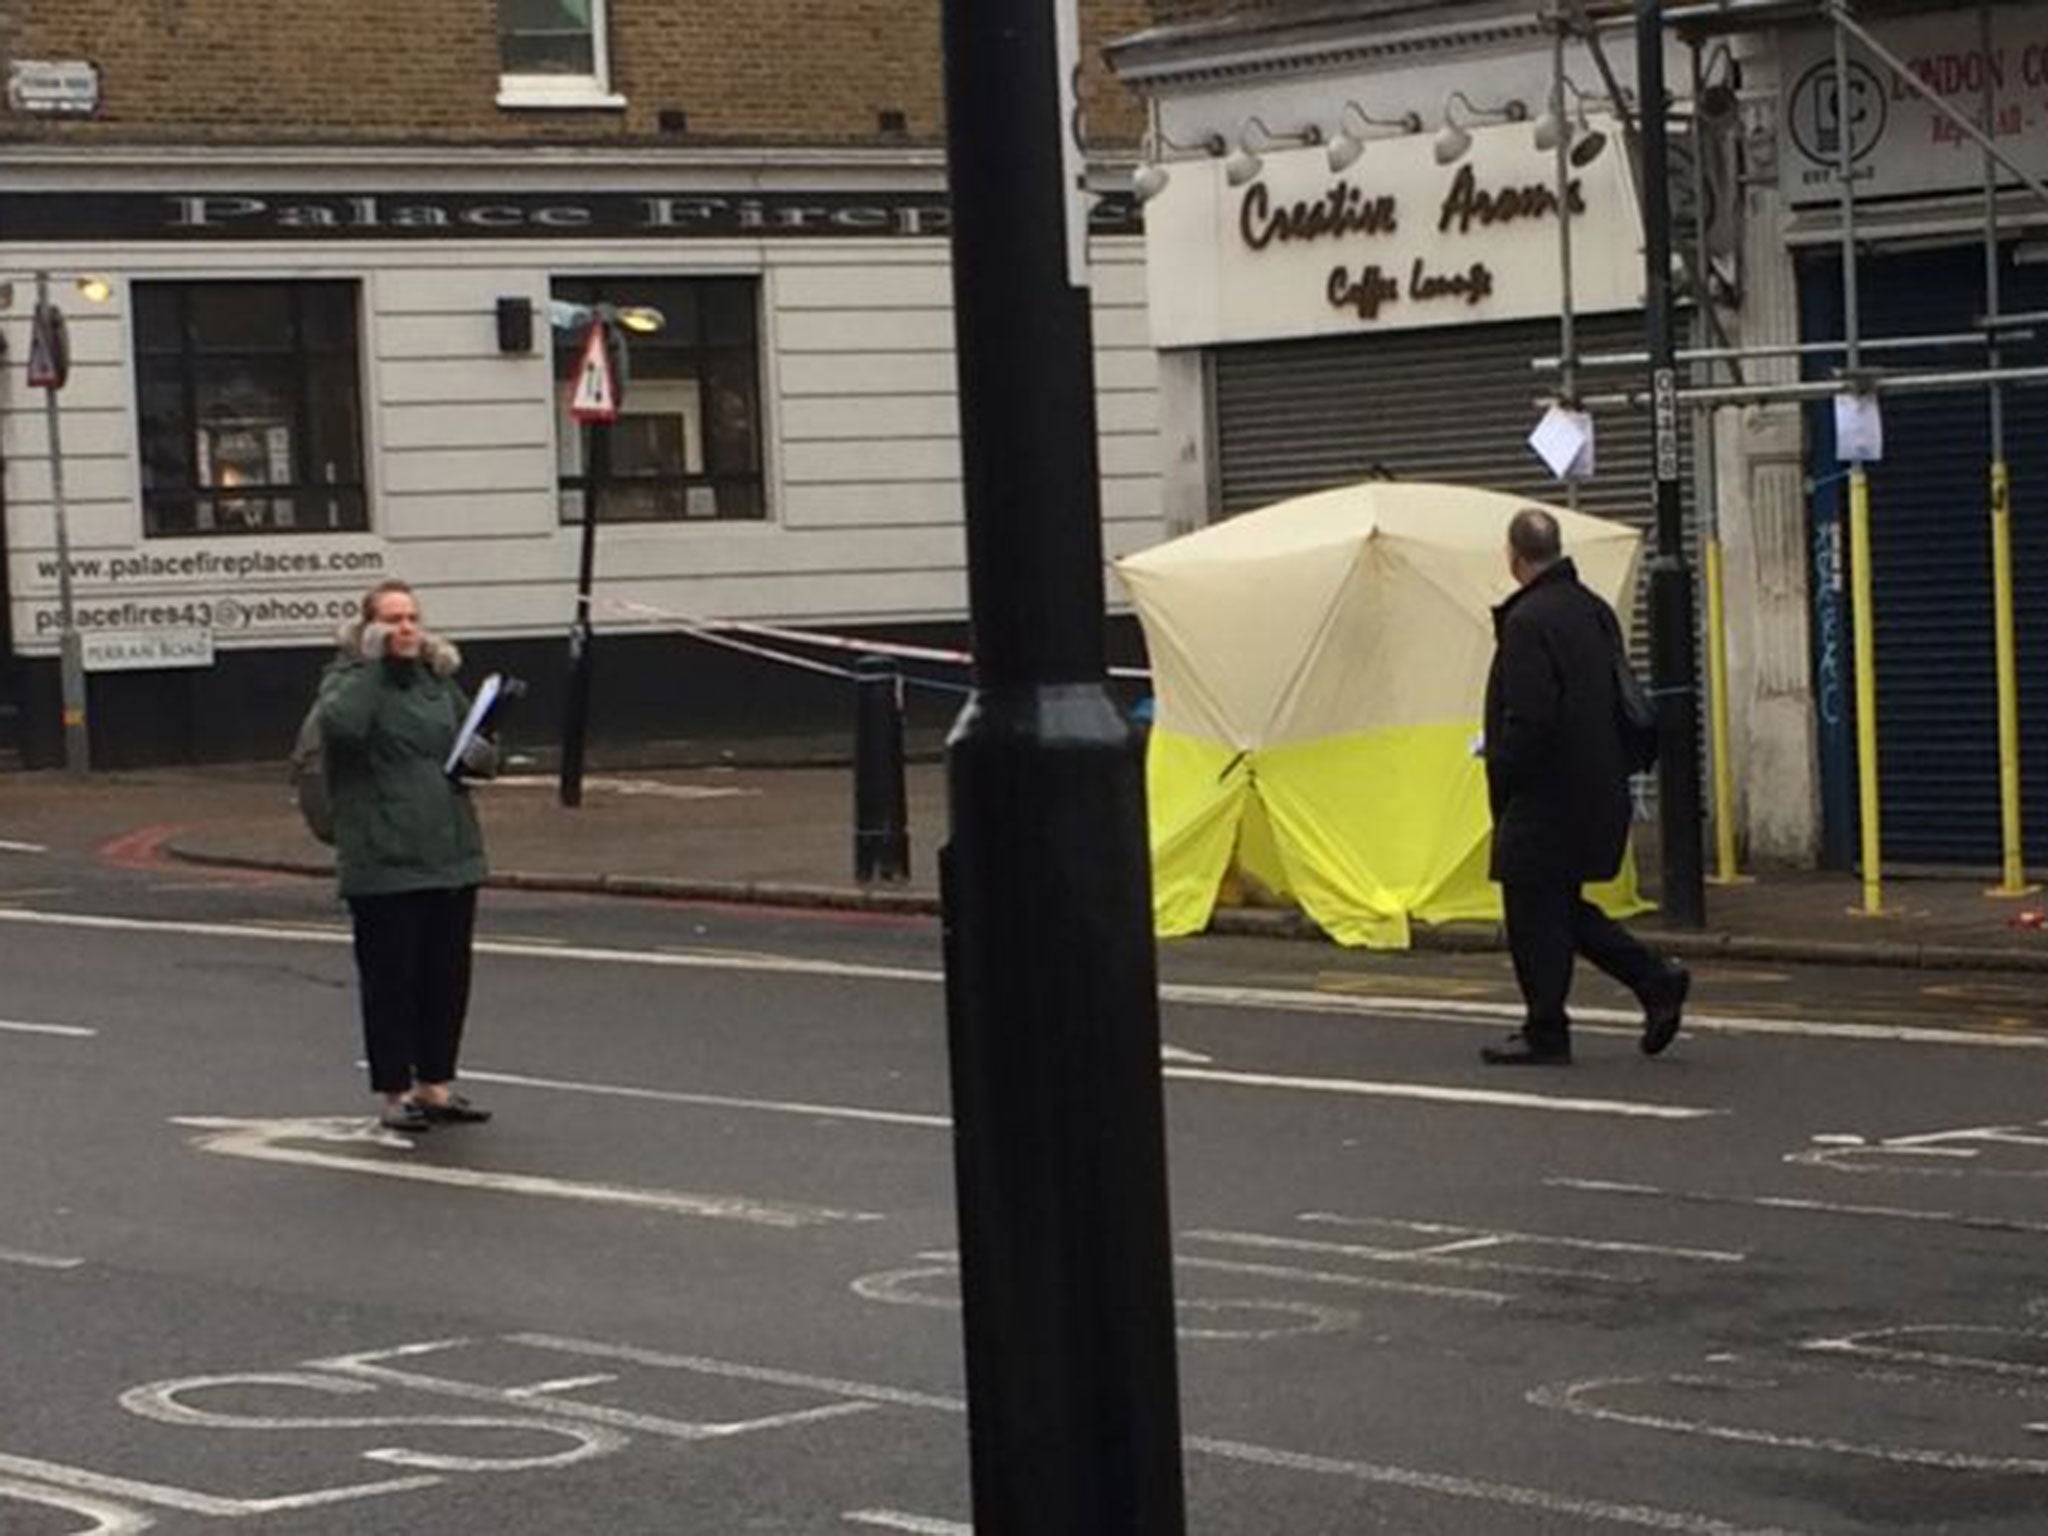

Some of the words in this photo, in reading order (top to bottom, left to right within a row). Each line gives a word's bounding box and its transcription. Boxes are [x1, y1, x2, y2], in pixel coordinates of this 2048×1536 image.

[167, 196, 592, 228] Palace
[643, 198, 952, 233] Firep
[1240, 181, 1398, 250] Creative
[35, 598, 360, 635] paacefires43@yahoo.co
